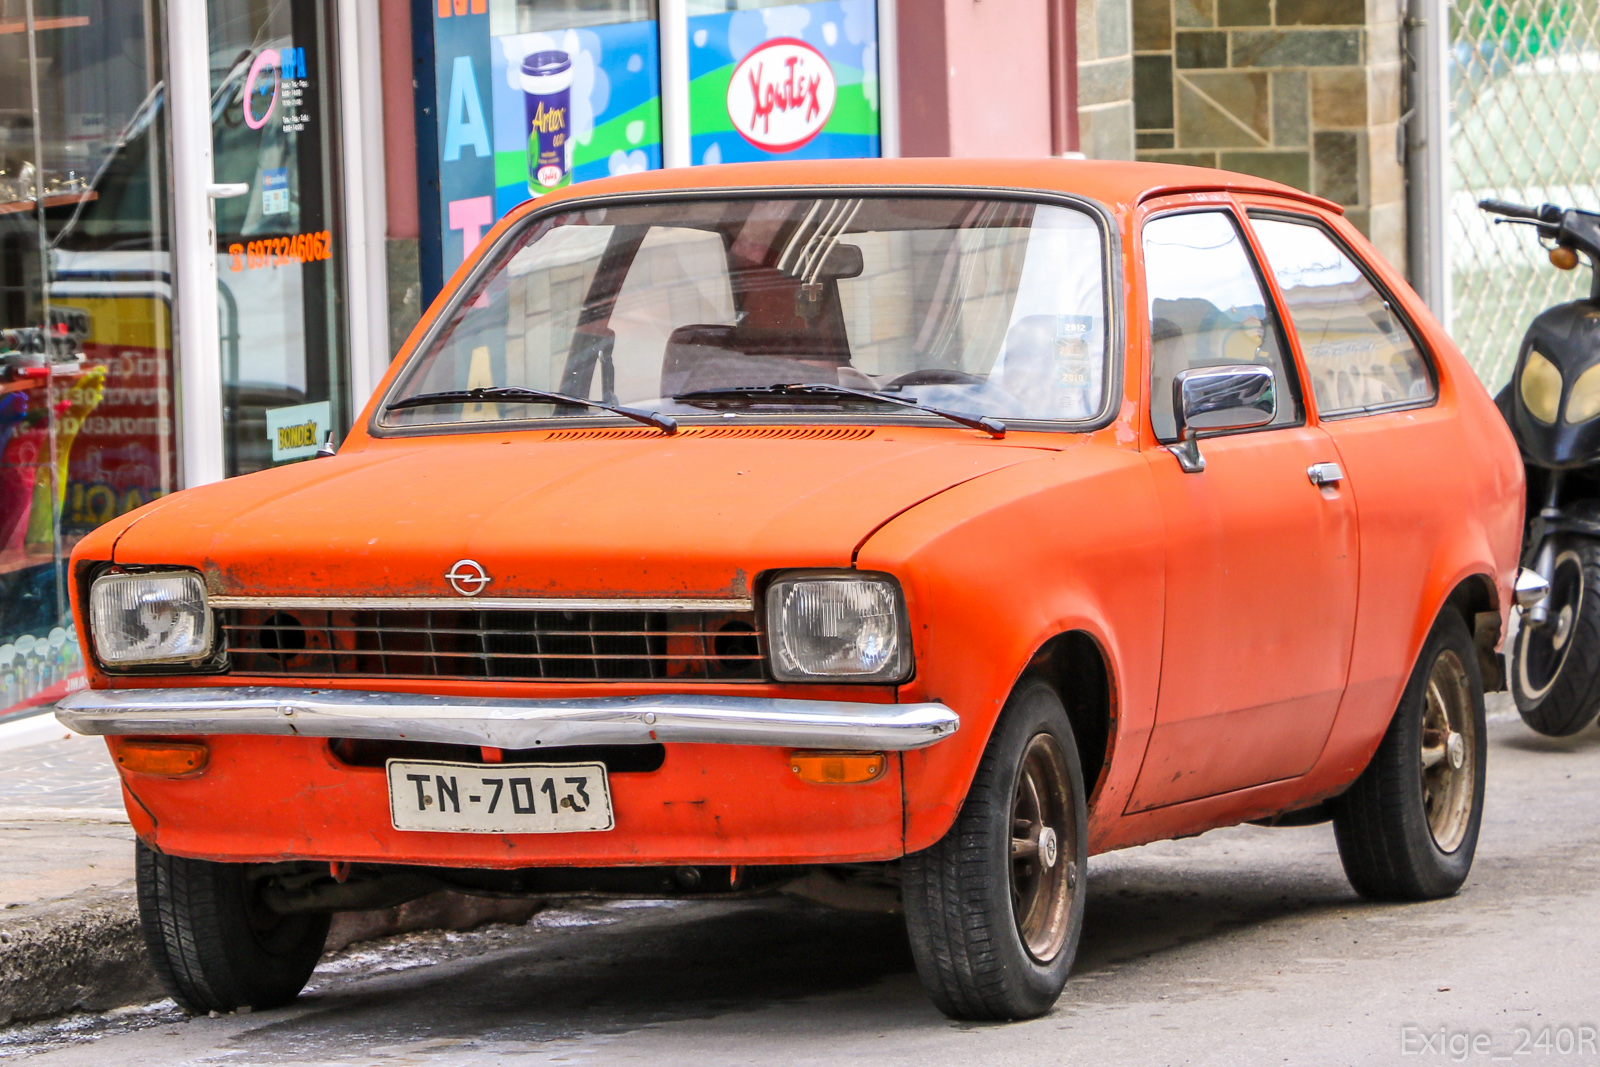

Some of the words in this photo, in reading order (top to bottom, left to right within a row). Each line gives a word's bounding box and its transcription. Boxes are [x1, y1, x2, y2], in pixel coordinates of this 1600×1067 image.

[532, 101, 566, 139] Artex
[247, 230, 332, 270] 6973246062
[1064, 323, 1086, 332] 2012
[277, 421, 318, 451] BONDEX
[406, 773, 591, 815] TN-7013
